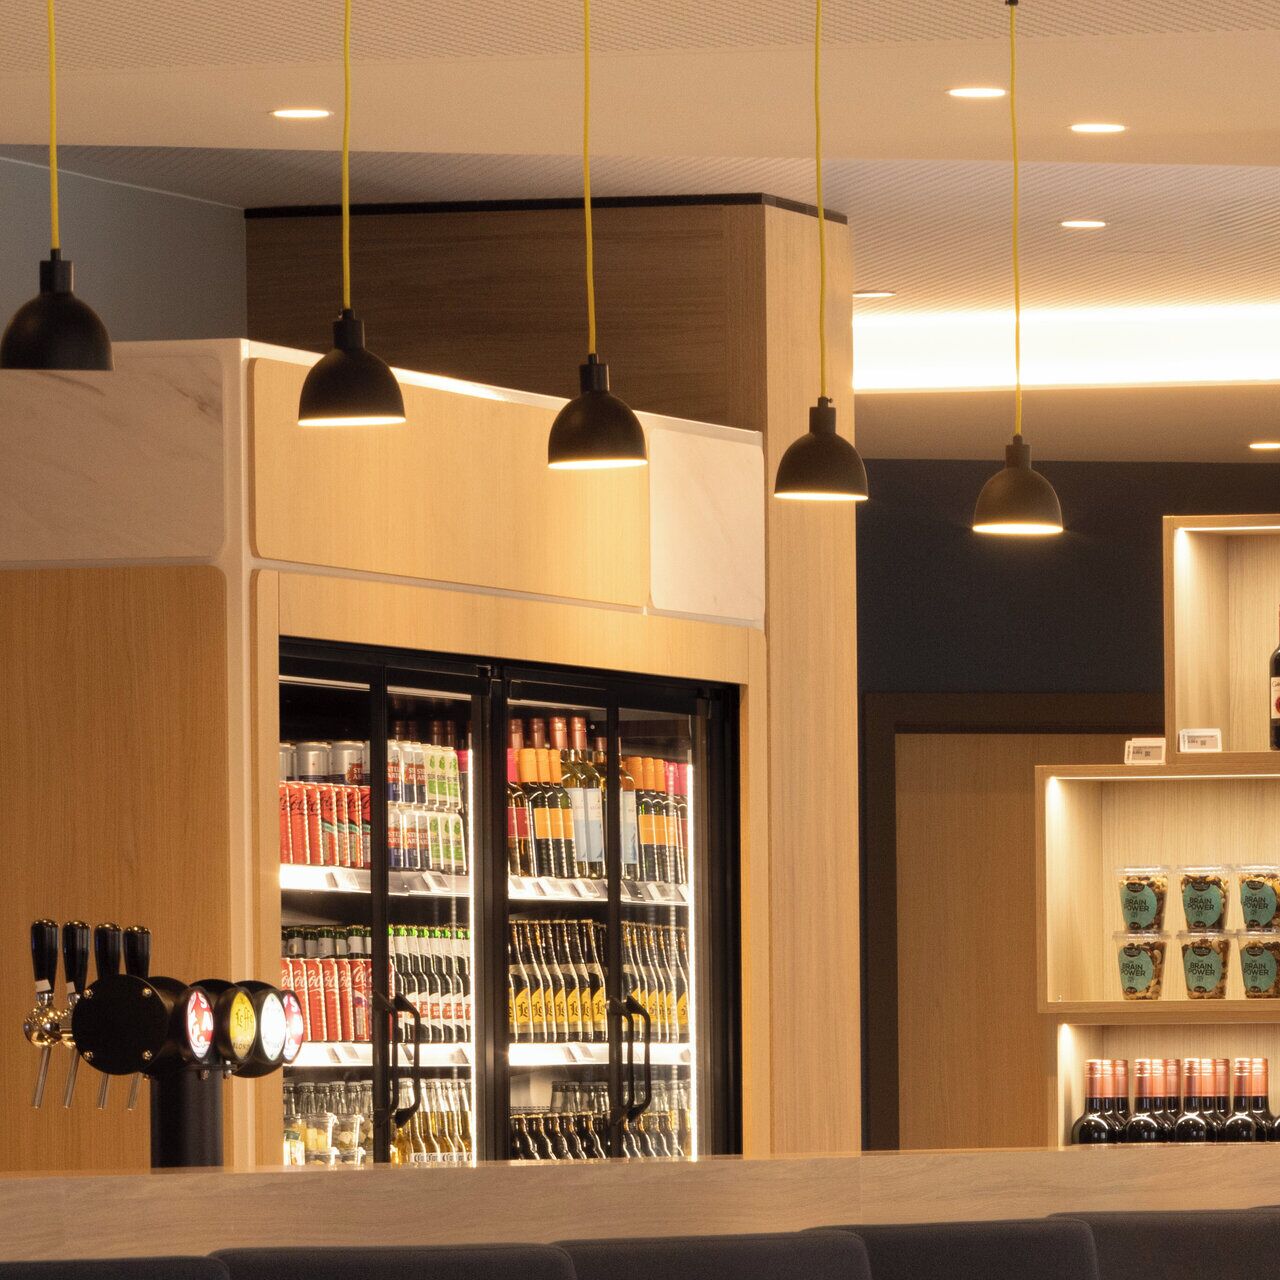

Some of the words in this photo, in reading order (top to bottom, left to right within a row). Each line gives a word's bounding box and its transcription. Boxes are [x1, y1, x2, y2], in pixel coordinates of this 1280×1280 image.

[1125, 898, 1147, 906] BRAIN
[1244, 895, 1266, 903] BRAIN
[1123, 904, 1150, 912] POWER
[1187, 903, 1215, 911] POWER
[1242, 901, 1269, 910] POWER
[1122, 962, 1143, 970] BRAIN
[1121, 969, 1146, 977] POWER
[1188, 968, 1215, 976] POWER
[1243, 968, 1269, 976] POWER
